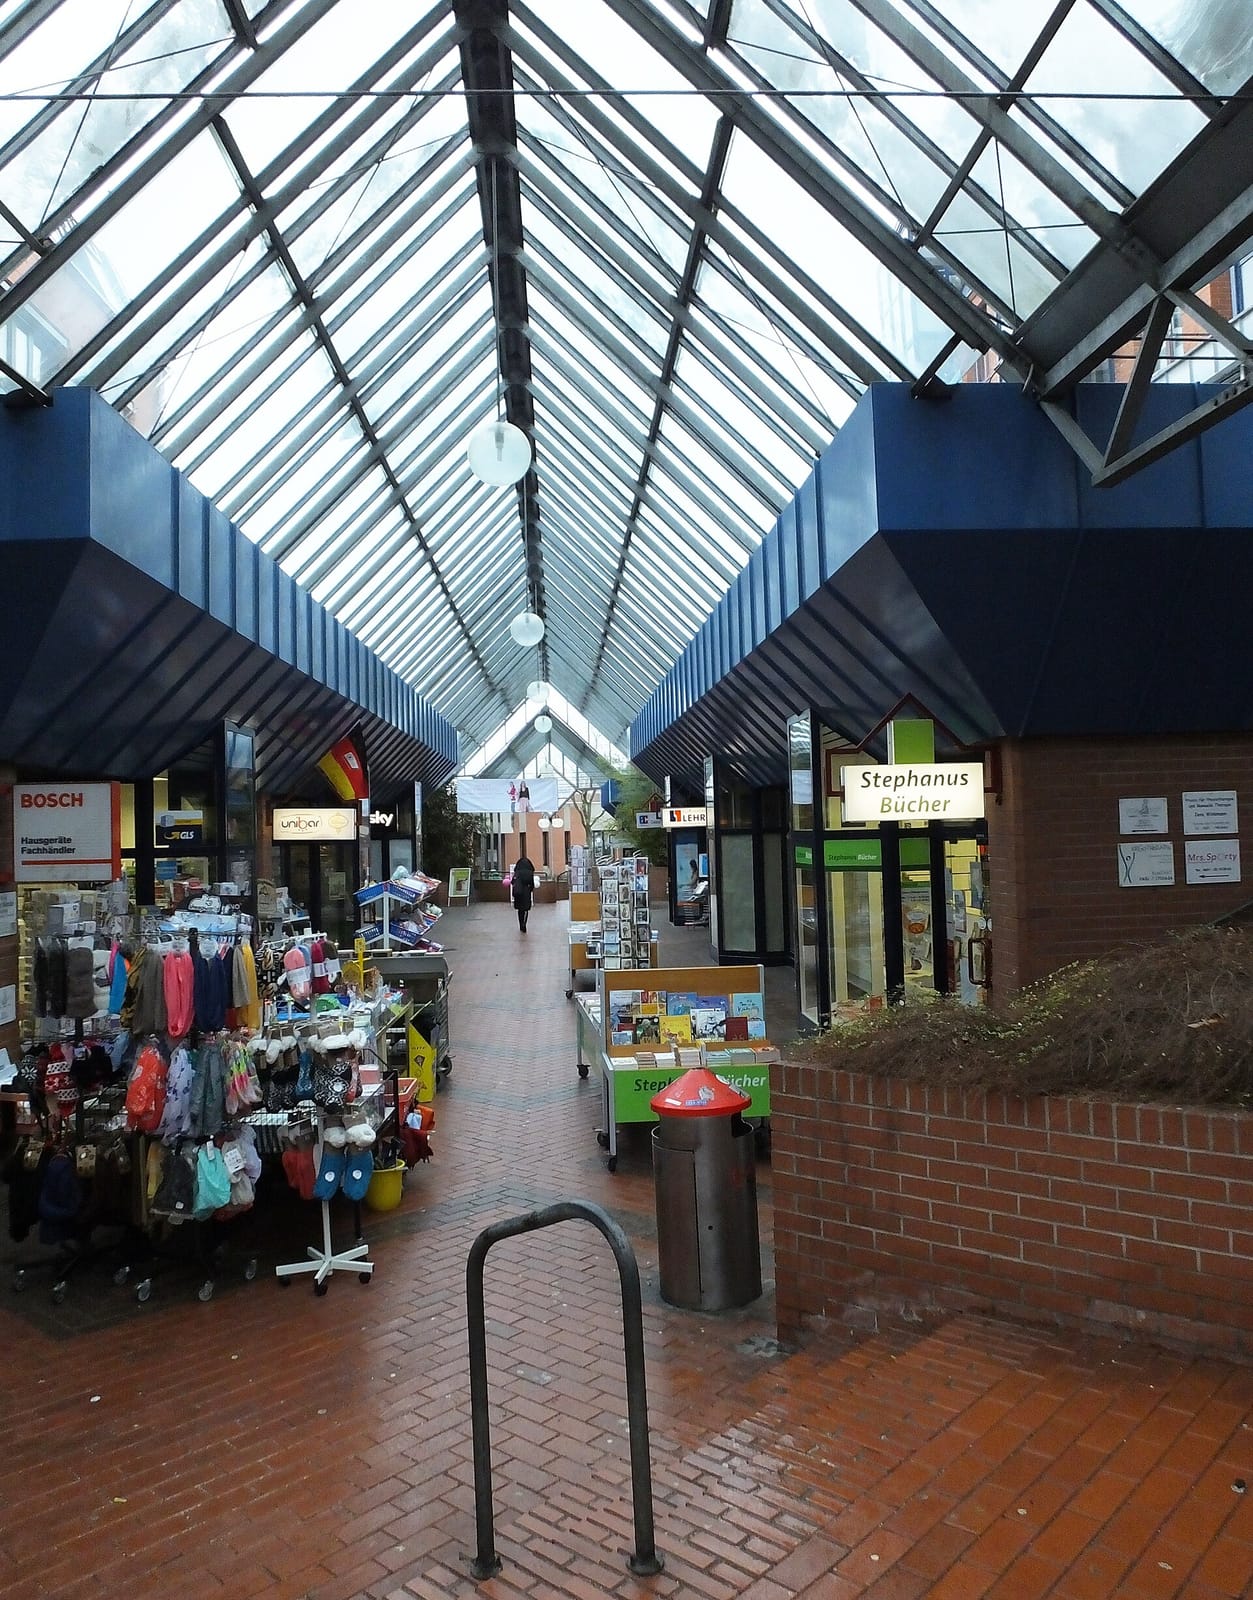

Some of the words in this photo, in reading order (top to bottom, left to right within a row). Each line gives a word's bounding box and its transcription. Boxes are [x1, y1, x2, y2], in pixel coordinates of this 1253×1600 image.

[861, 770, 969, 792] Stephanus
[20, 793, 83, 808] BOSCH
[880, 795, 951, 814] Bücher
[281, 816, 320, 830] unibar
[369, 810, 394, 827] sky
[683, 814, 706, 822] LEHR
[20, 836, 72, 846] Hausgeräte
[180, 831, 195, 840] GLS
[20, 847, 76, 855] Fachhändler
[727, 1074, 767, 1088] ücher
